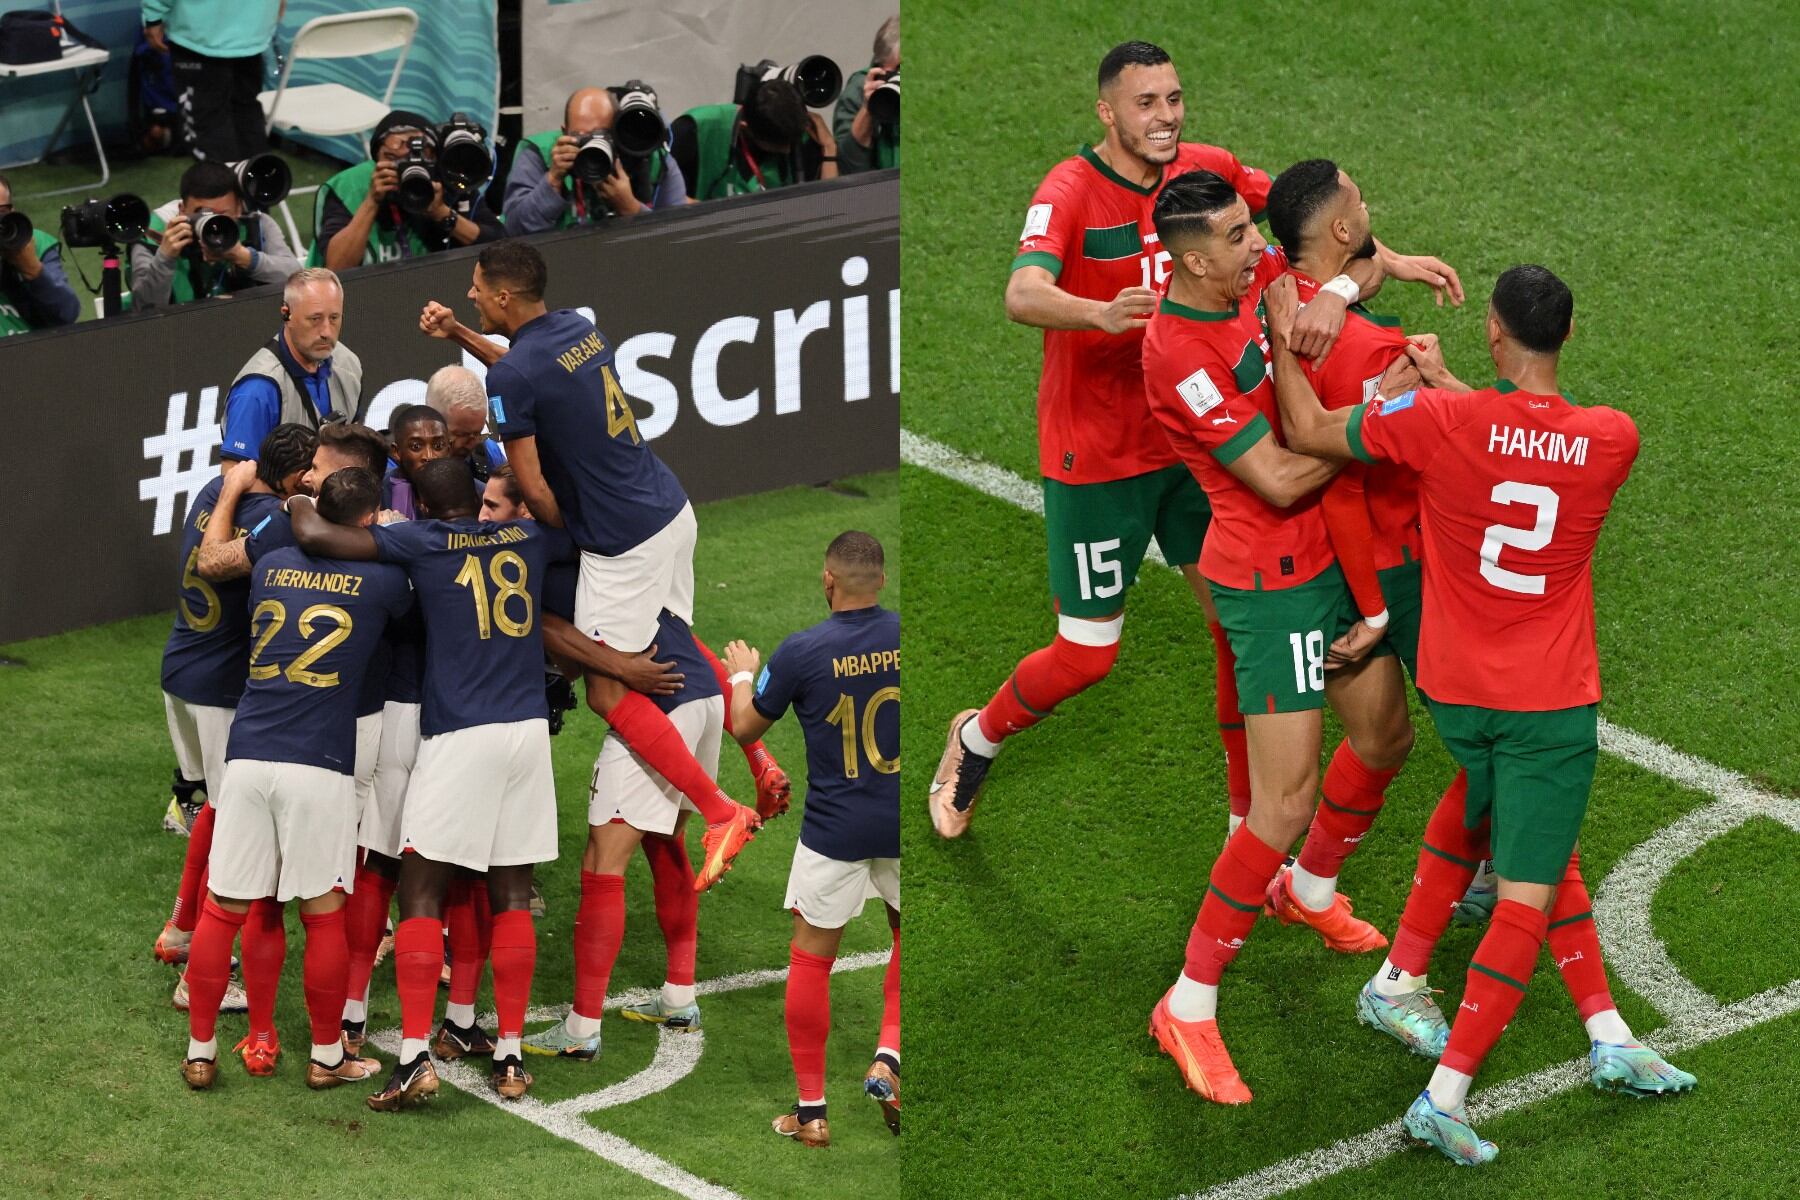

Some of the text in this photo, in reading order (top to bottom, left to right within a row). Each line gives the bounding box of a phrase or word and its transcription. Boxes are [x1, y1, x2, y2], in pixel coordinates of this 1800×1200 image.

[556, 331, 605, 373] VARANE
[600, 365, 640, 446] 4
[1488, 424, 1590, 466] HAKIMI
[1073, 537, 1124, 600] 15
[1479, 480, 1560, 595] 2
[181, 545, 221, 633] 5
[264, 568, 363, 596] T.HERNANDEZ
[454, 550, 534, 640] 18
[249, 600, 353, 688] 22
[1289, 629, 1325, 694] 18
[825, 686, 900, 779] 10
